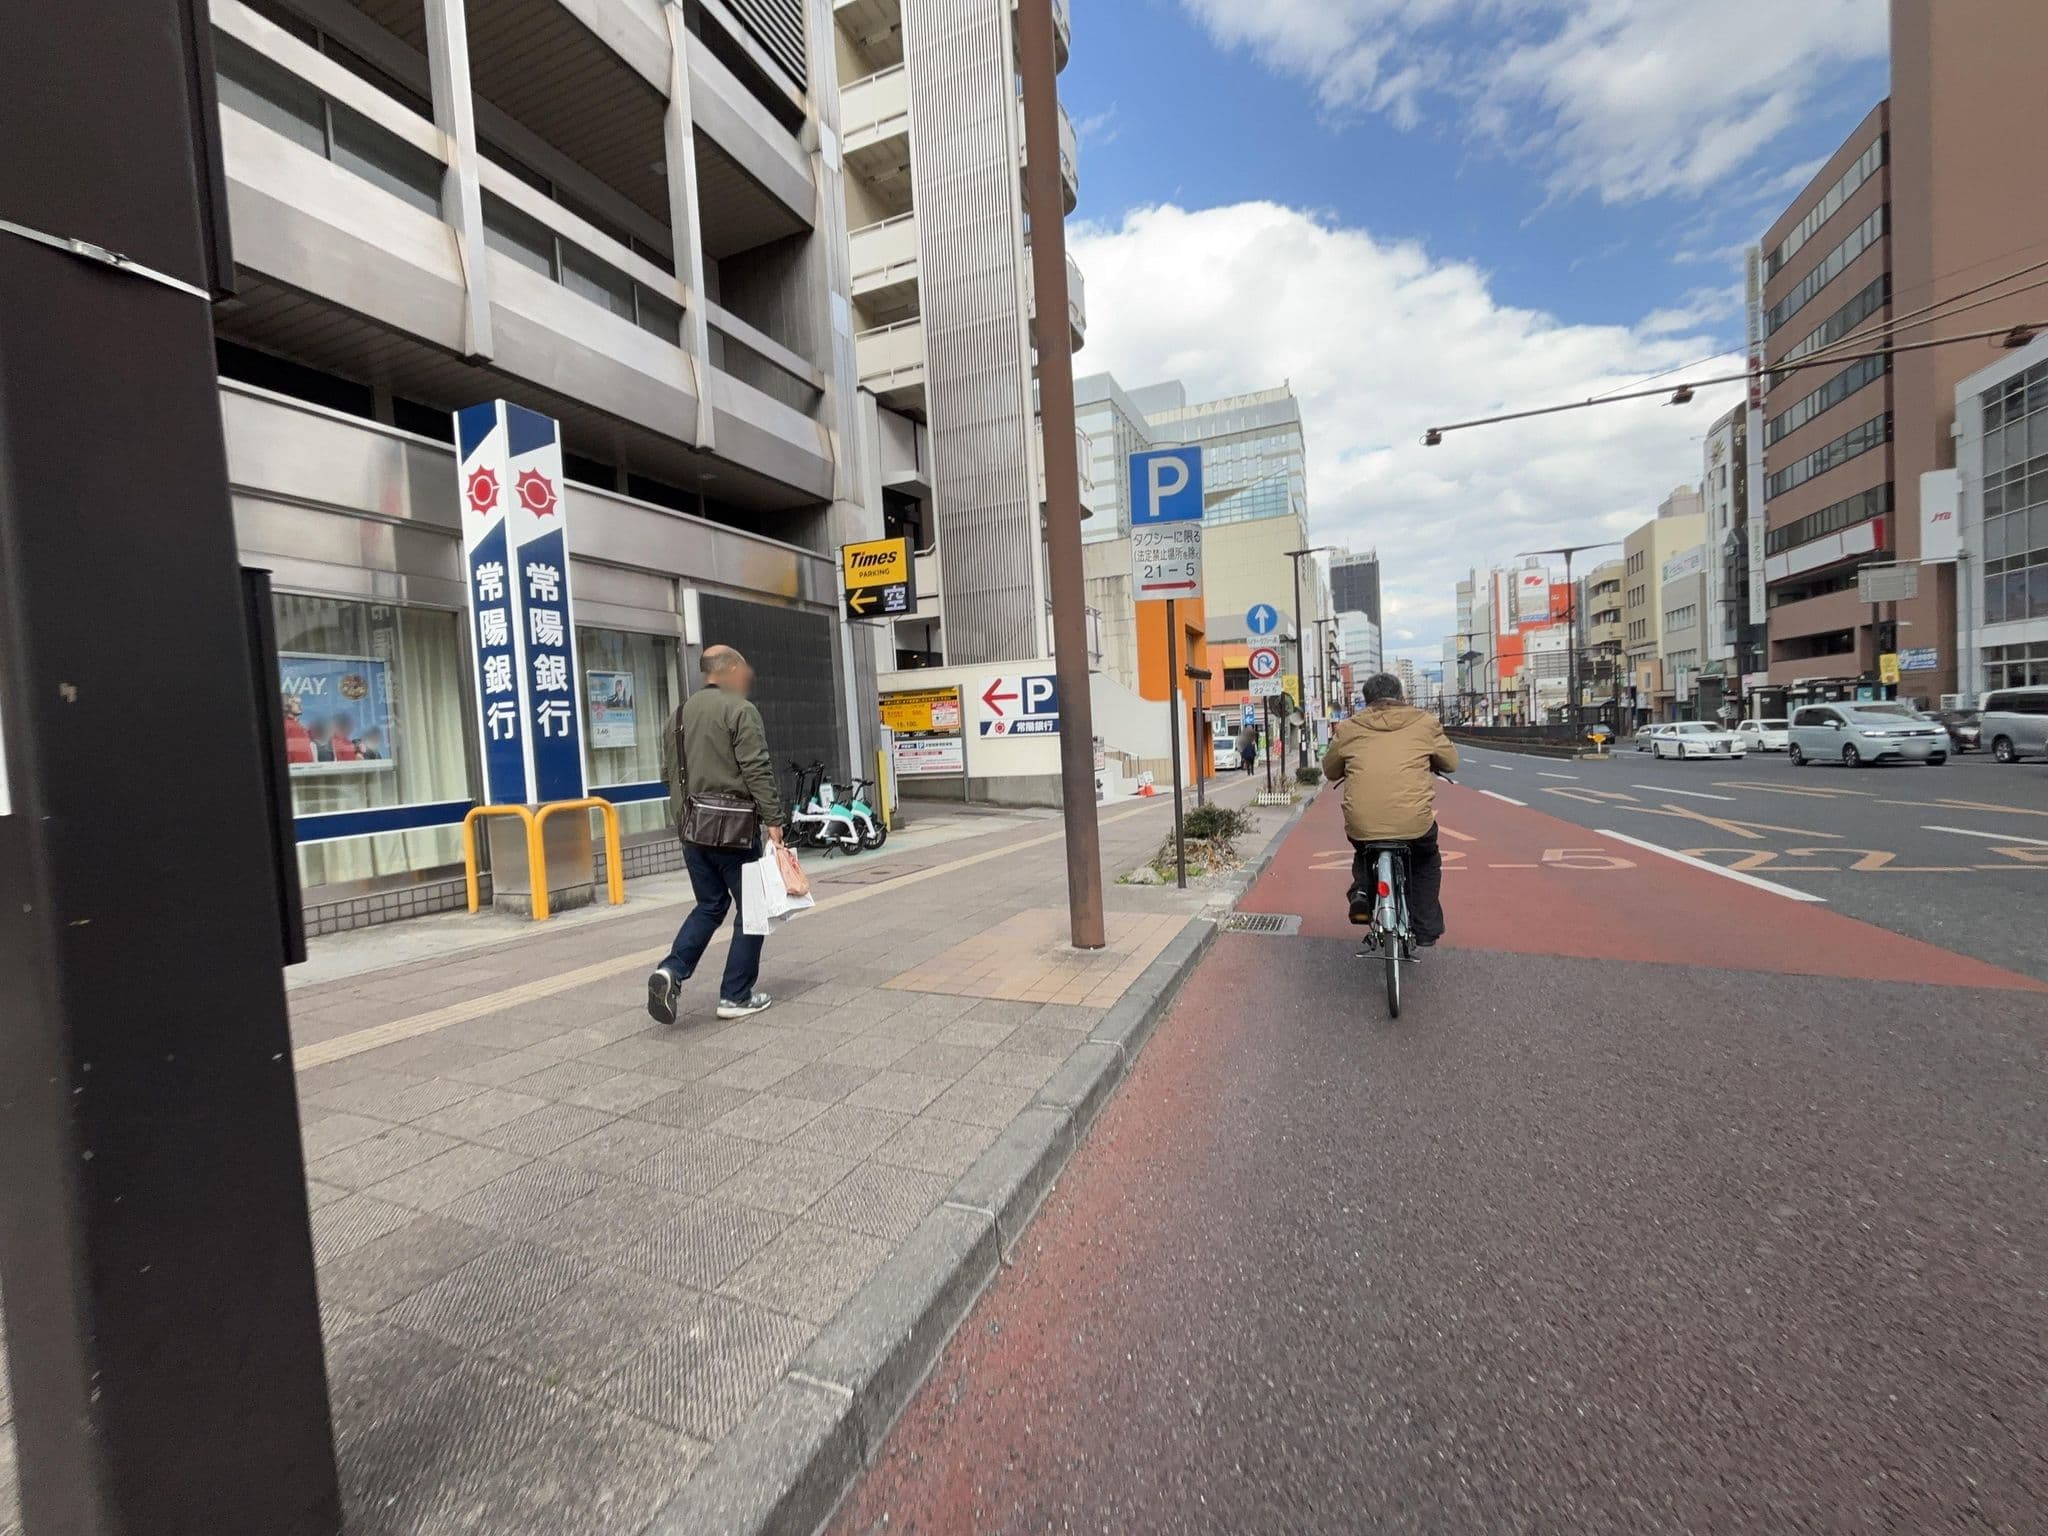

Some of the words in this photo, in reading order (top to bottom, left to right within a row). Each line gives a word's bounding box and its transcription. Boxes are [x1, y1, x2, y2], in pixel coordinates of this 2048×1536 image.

[1148, 456, 1189, 517] P
[1133, 529, 1201, 547] タクシーに限る
[850, 551, 898, 569] Times
[858, 568, 890, 578] PARKING
[883, 585, 907, 612] 空
[475, 562, 515, 742] 常陽銀行
[525, 562, 572, 740] 常陽銀行
[1026, 678, 1054, 714] P
